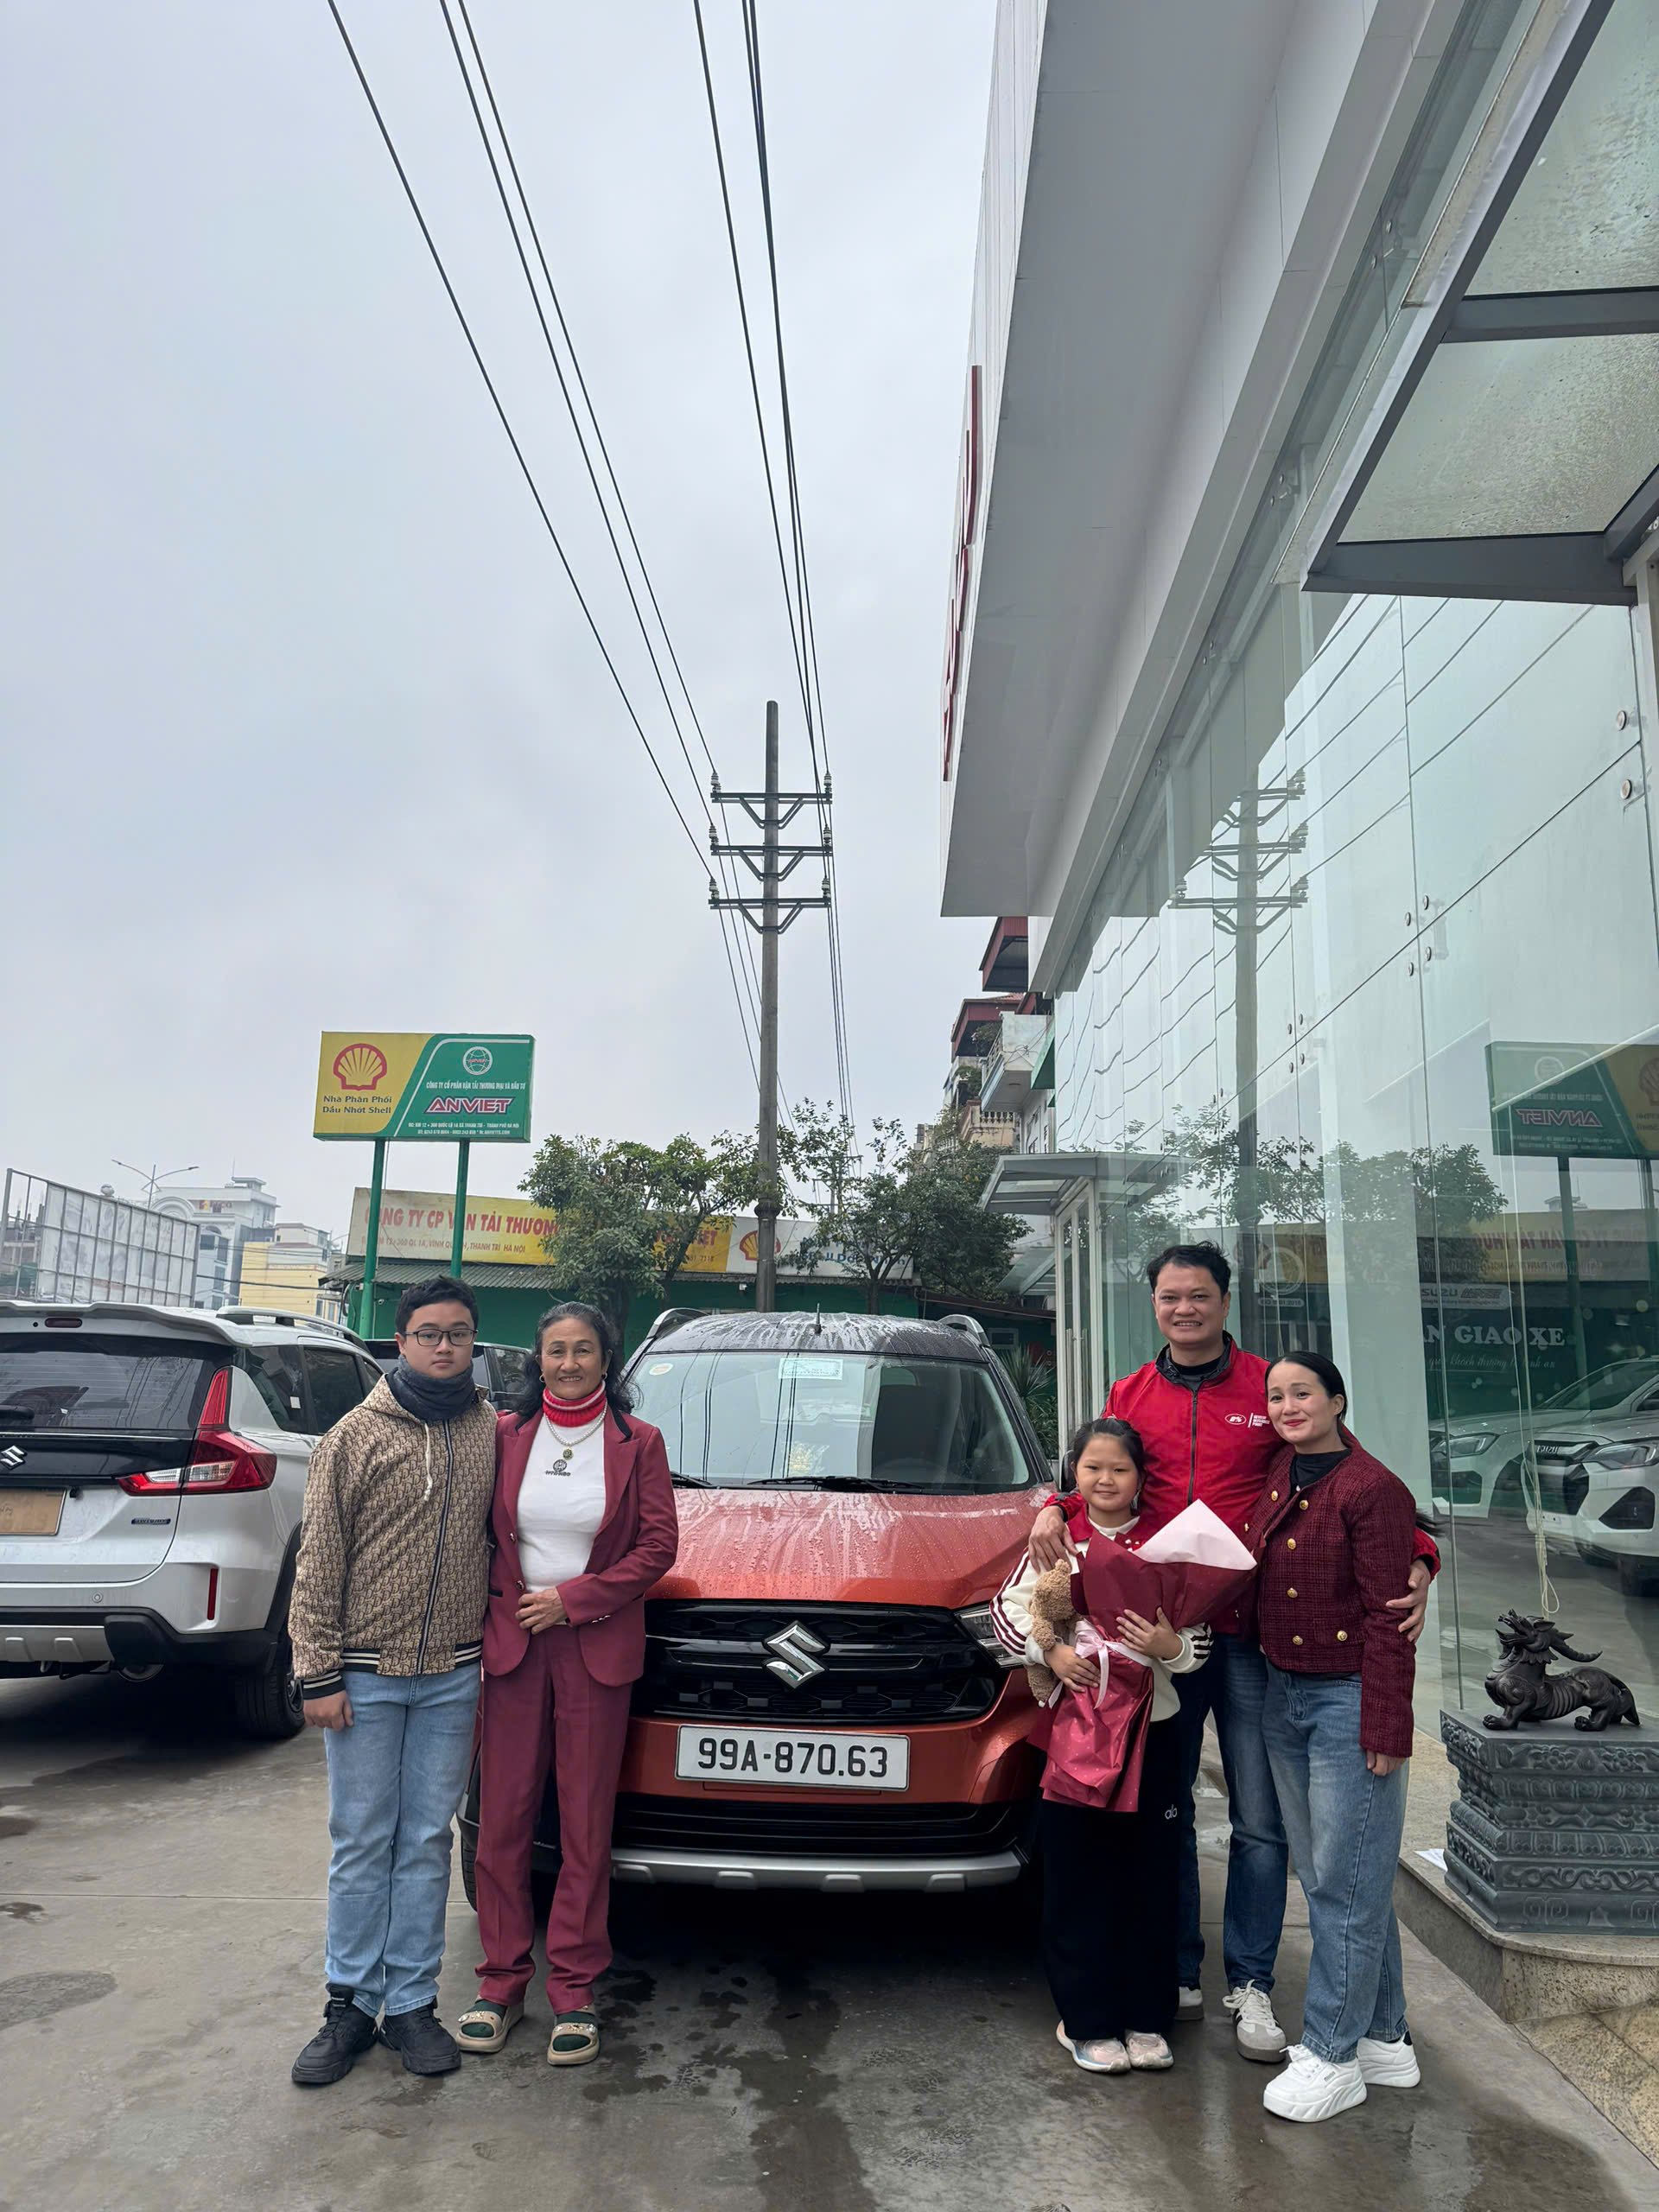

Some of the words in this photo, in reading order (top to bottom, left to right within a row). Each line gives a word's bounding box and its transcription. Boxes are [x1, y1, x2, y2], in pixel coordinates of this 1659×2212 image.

[425, 1096, 513, 1114] ANVIET
[408, 1210, 424, 1227] TY
[428, 1211, 444, 1229] CP
[480, 1211, 502, 1232] TẢI
[1454, 1325, 1522, 1345] GIAO
[1529, 1327, 1566, 1347] XE
[698, 1737, 888, 1778] 99A-870.63
